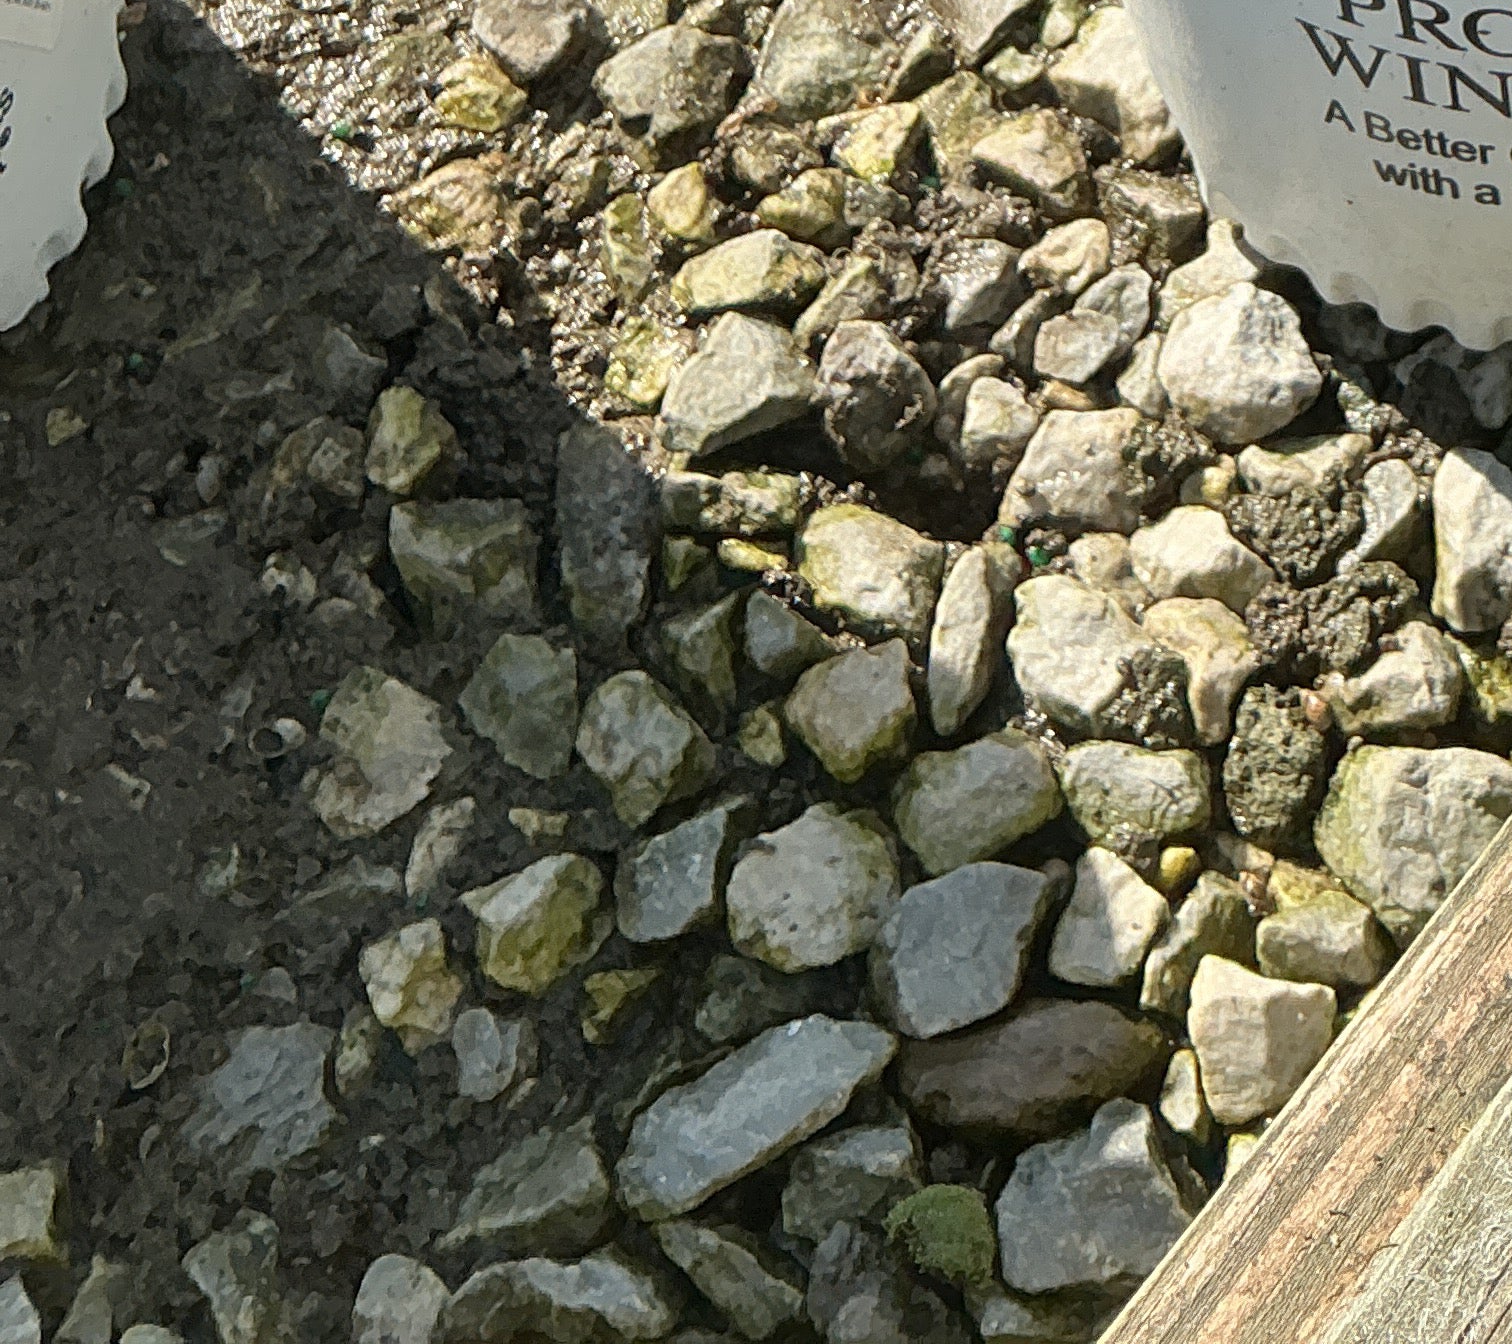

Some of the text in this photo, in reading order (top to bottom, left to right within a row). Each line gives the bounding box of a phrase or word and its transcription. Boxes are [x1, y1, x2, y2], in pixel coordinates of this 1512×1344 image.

[1324, 98, 1356, 134] A
[1364, 110, 1496, 166] Better
[1373, 158, 1461, 200] with
[1474, 182, 1502, 208] a
